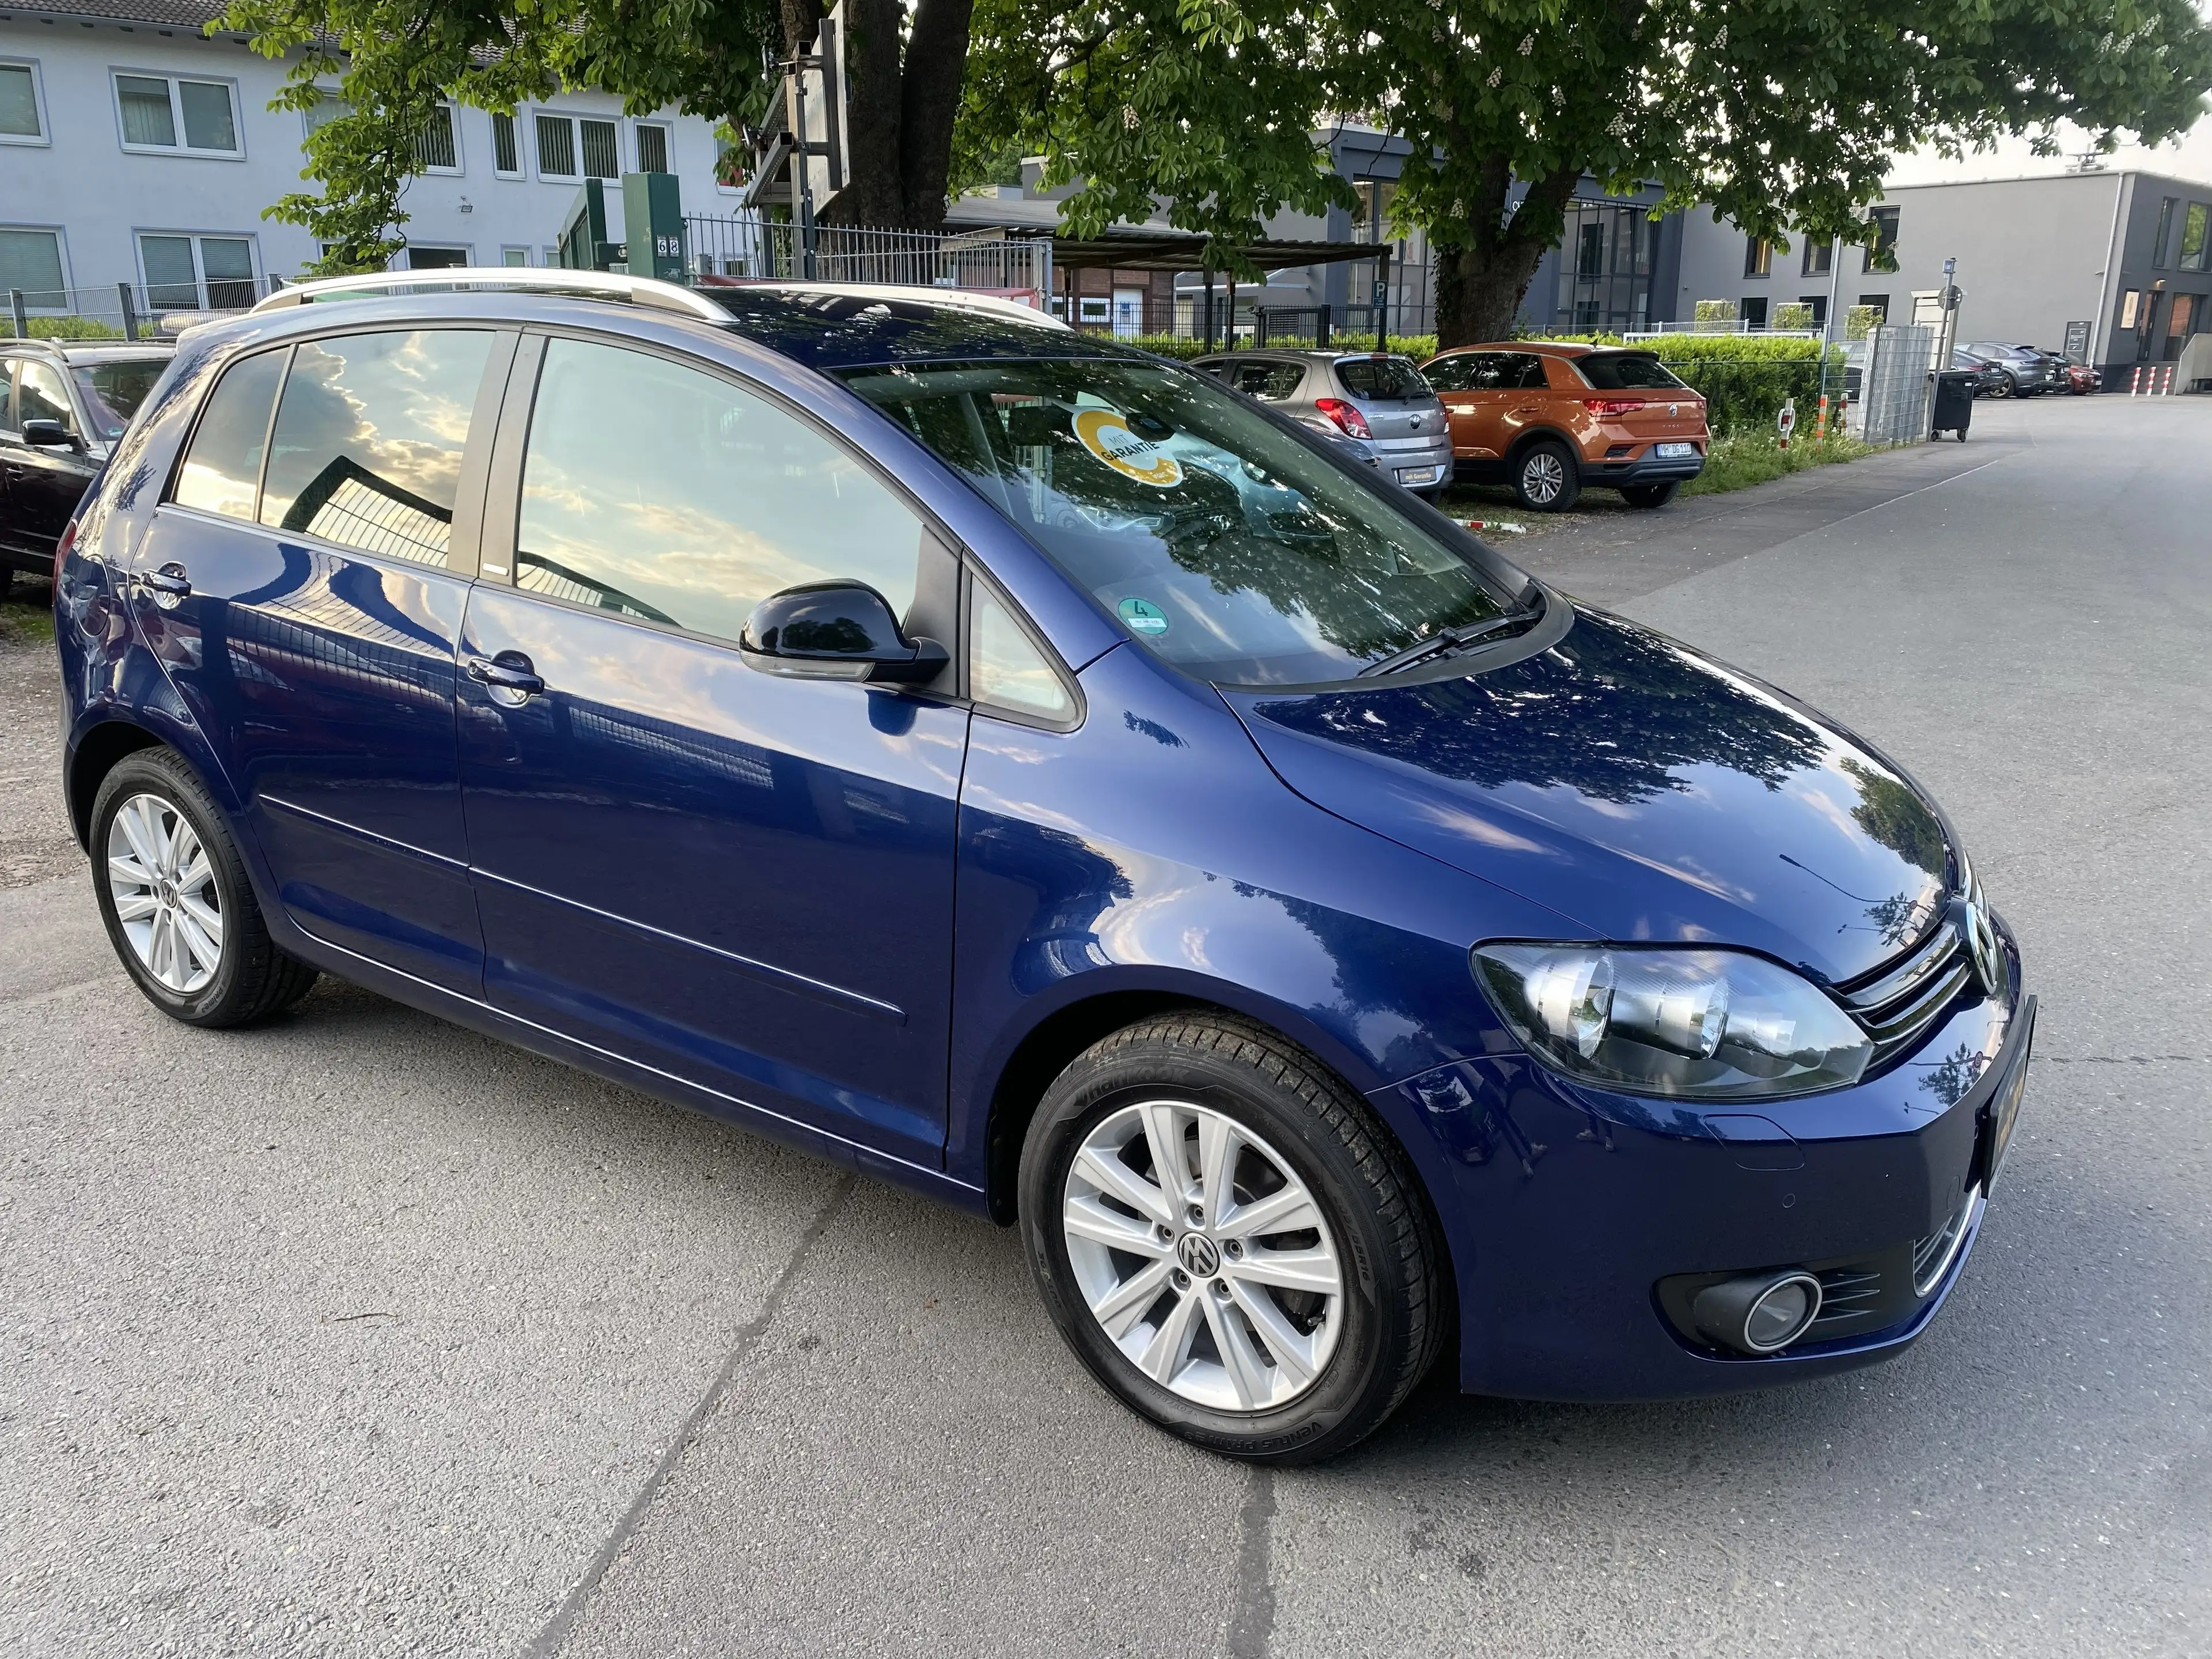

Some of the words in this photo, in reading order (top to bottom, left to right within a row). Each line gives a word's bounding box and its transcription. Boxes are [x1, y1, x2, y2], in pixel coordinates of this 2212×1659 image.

[660, 241, 678, 252] 68
[1376, 282, 1385, 297] P
[1108, 434, 1129, 445] MIT
[1101, 441, 1160, 461] GARANTIE
[1134, 601, 1148, 616] 4
